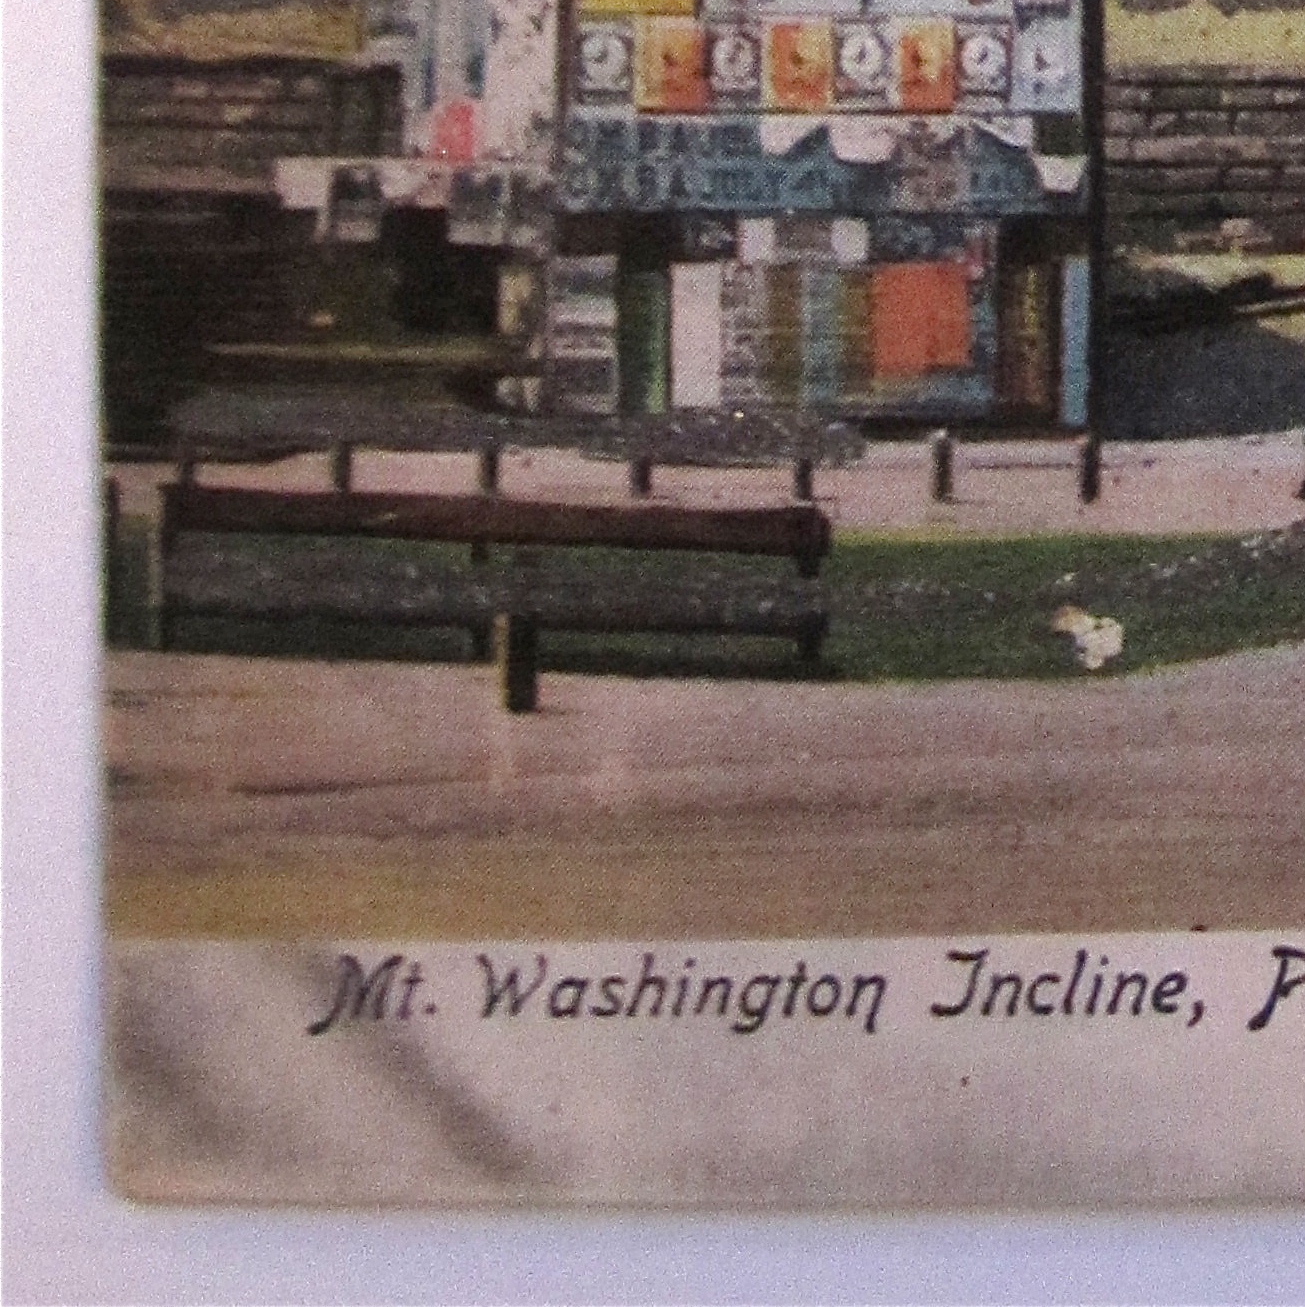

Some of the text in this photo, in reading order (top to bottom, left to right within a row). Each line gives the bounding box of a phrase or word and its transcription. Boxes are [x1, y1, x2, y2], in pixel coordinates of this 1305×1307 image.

[307, 954, 436, 1036] Mt.
[476, 953, 887, 1035] Washington
[929, 949, 1205, 1028] Incline,
